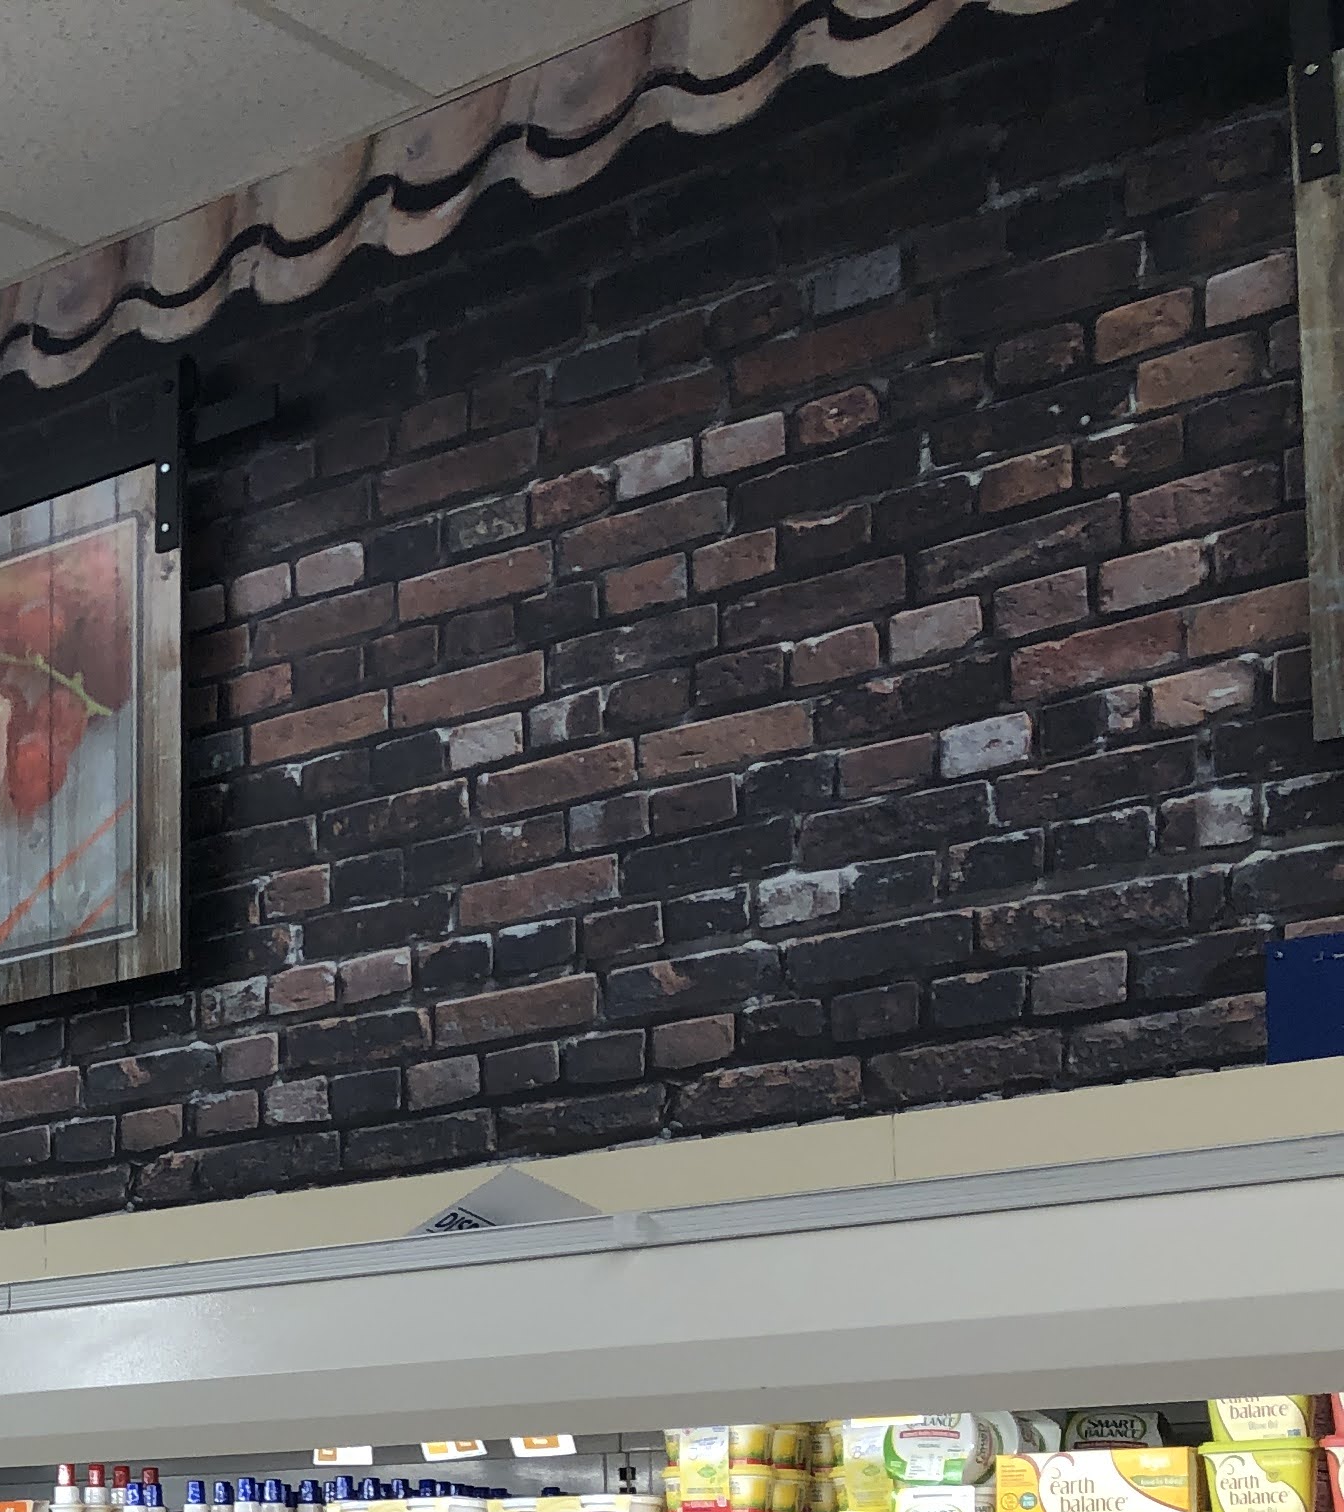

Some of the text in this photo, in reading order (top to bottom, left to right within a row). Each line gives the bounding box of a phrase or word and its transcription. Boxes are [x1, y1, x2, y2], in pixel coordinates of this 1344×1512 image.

[1229, 1402, 1289, 1420] balance
[1087, 1418, 1135, 1430] SMART
[1084, 1428, 1140, 1440] BALANCE
[1049, 1476, 1095, 1495] earth
[1220, 1474, 1260, 1491] earth
[1229, 1490, 1289, 1507] balance
